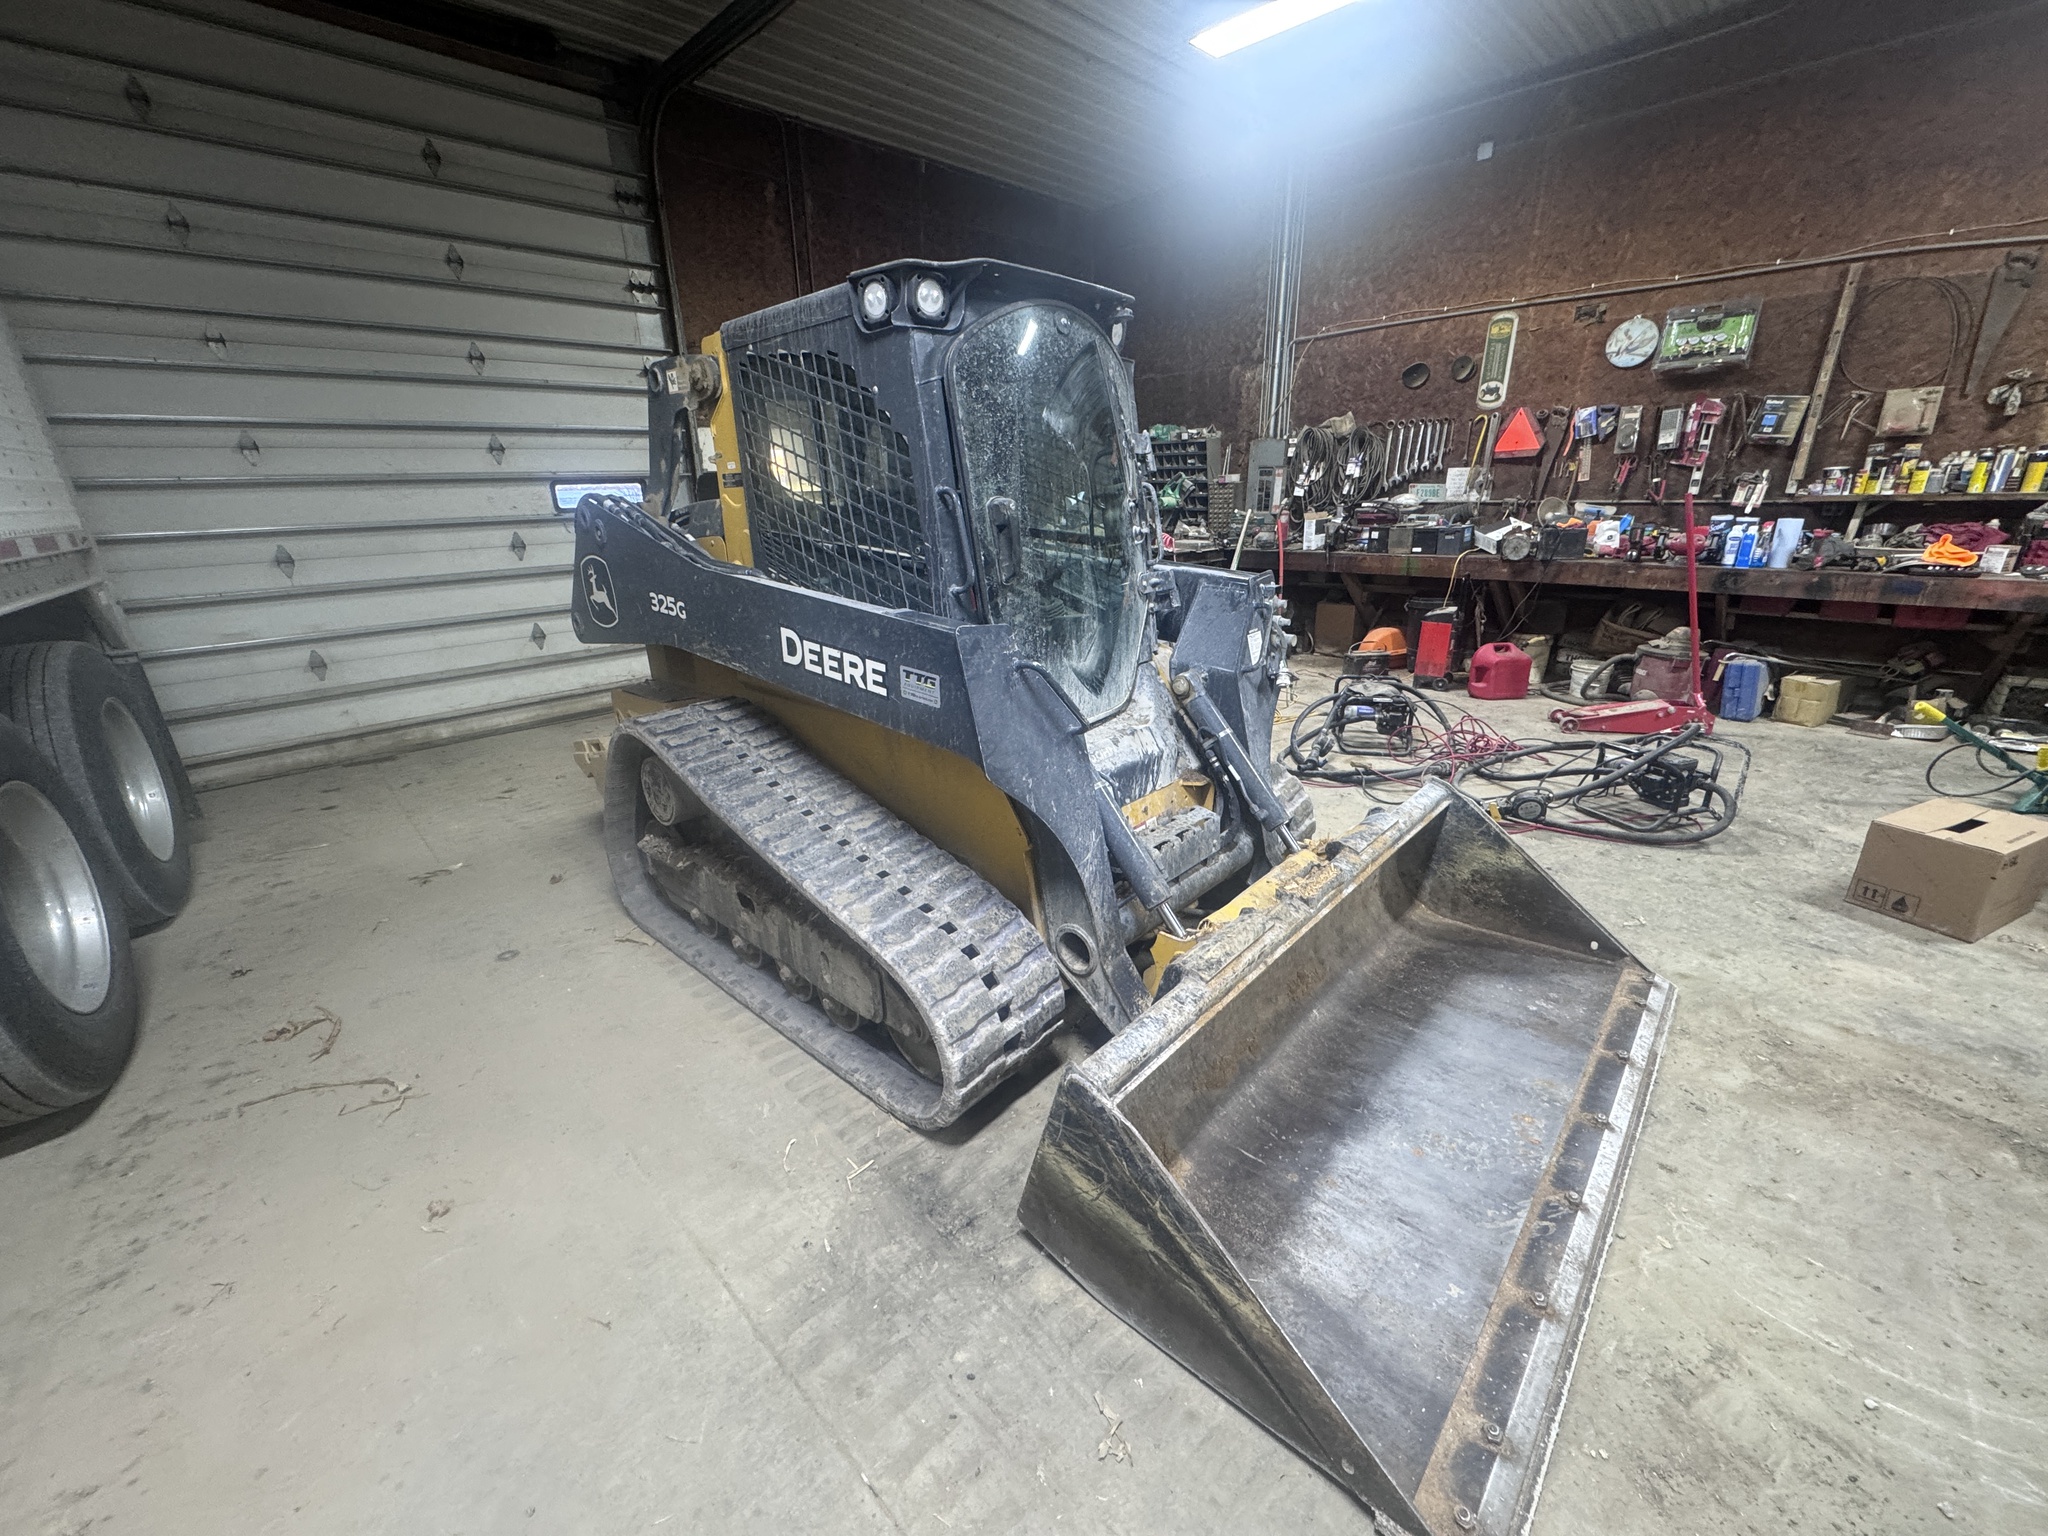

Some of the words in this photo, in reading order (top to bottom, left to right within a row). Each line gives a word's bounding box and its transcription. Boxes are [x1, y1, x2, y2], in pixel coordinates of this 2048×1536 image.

[649, 592, 687, 620] 325G
[780, 626, 888, 697] DEERE
[902, 669, 937, 689] TTG
[903, 682, 936, 694] EQUIPMENT
